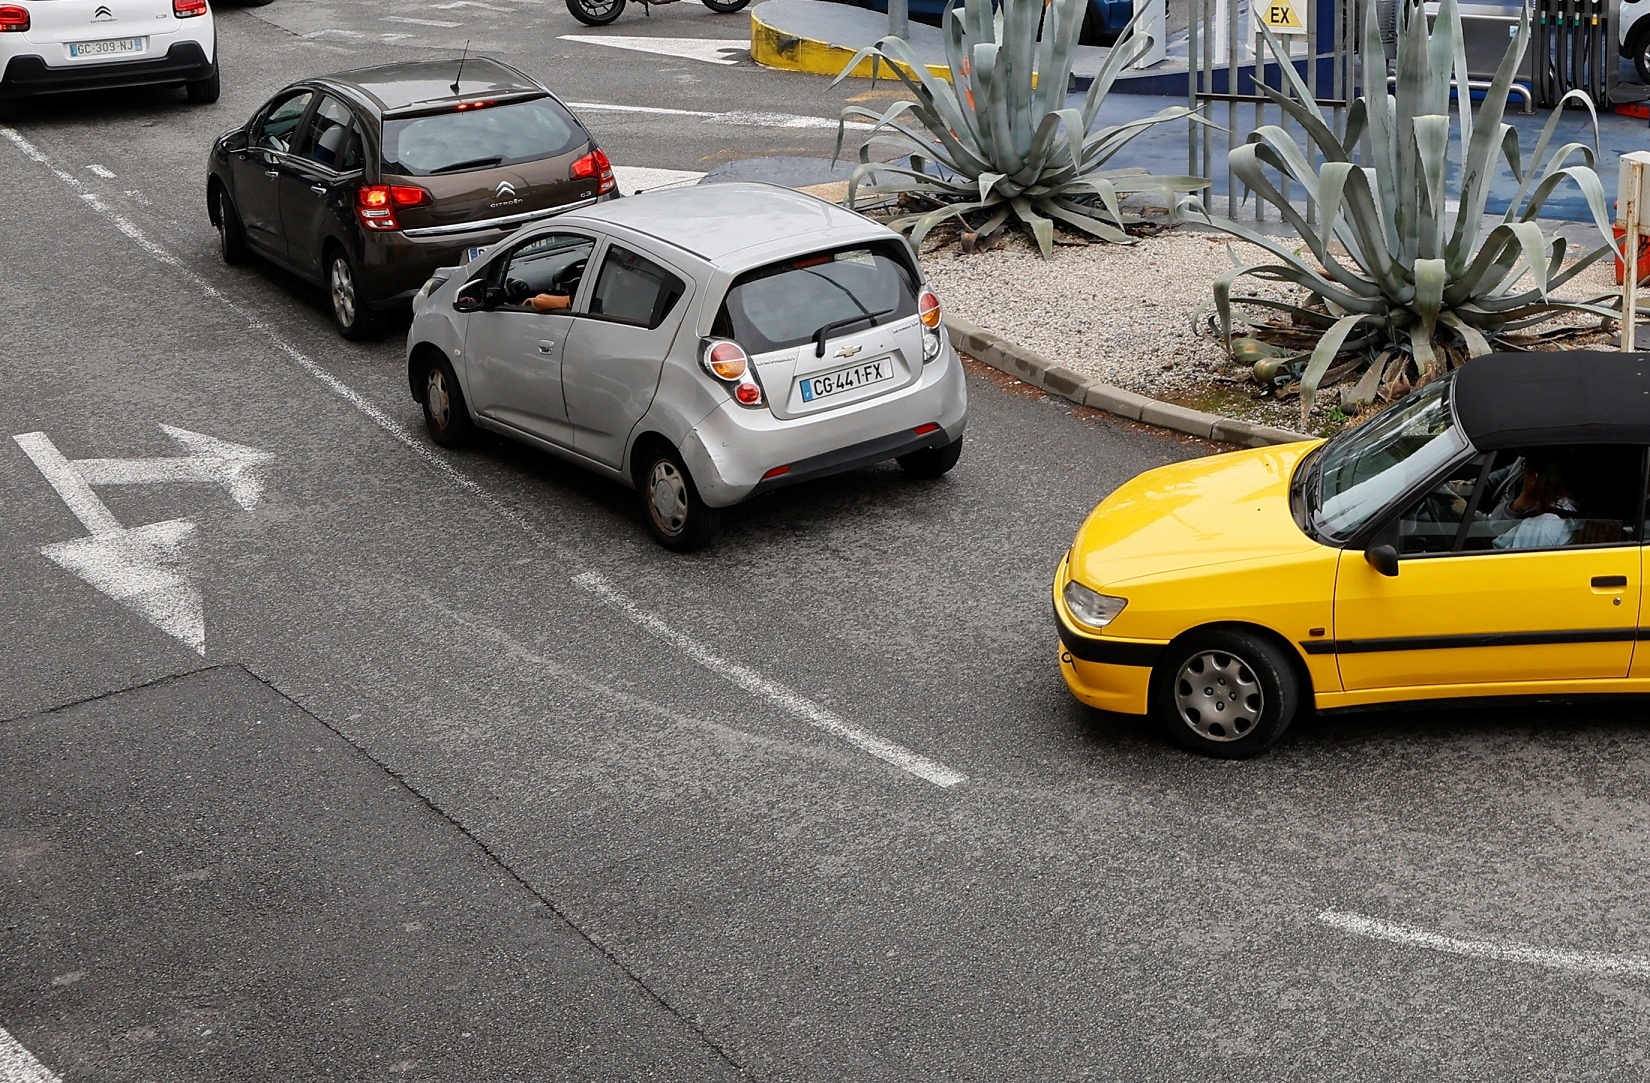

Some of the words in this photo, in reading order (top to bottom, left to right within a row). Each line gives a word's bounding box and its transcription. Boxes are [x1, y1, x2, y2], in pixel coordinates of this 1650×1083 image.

[1271, 6, 1290, 24] EX
[77, 40, 133, 54] GC-309-NJ
[813, 363, 883, 396] CG-441-FX
